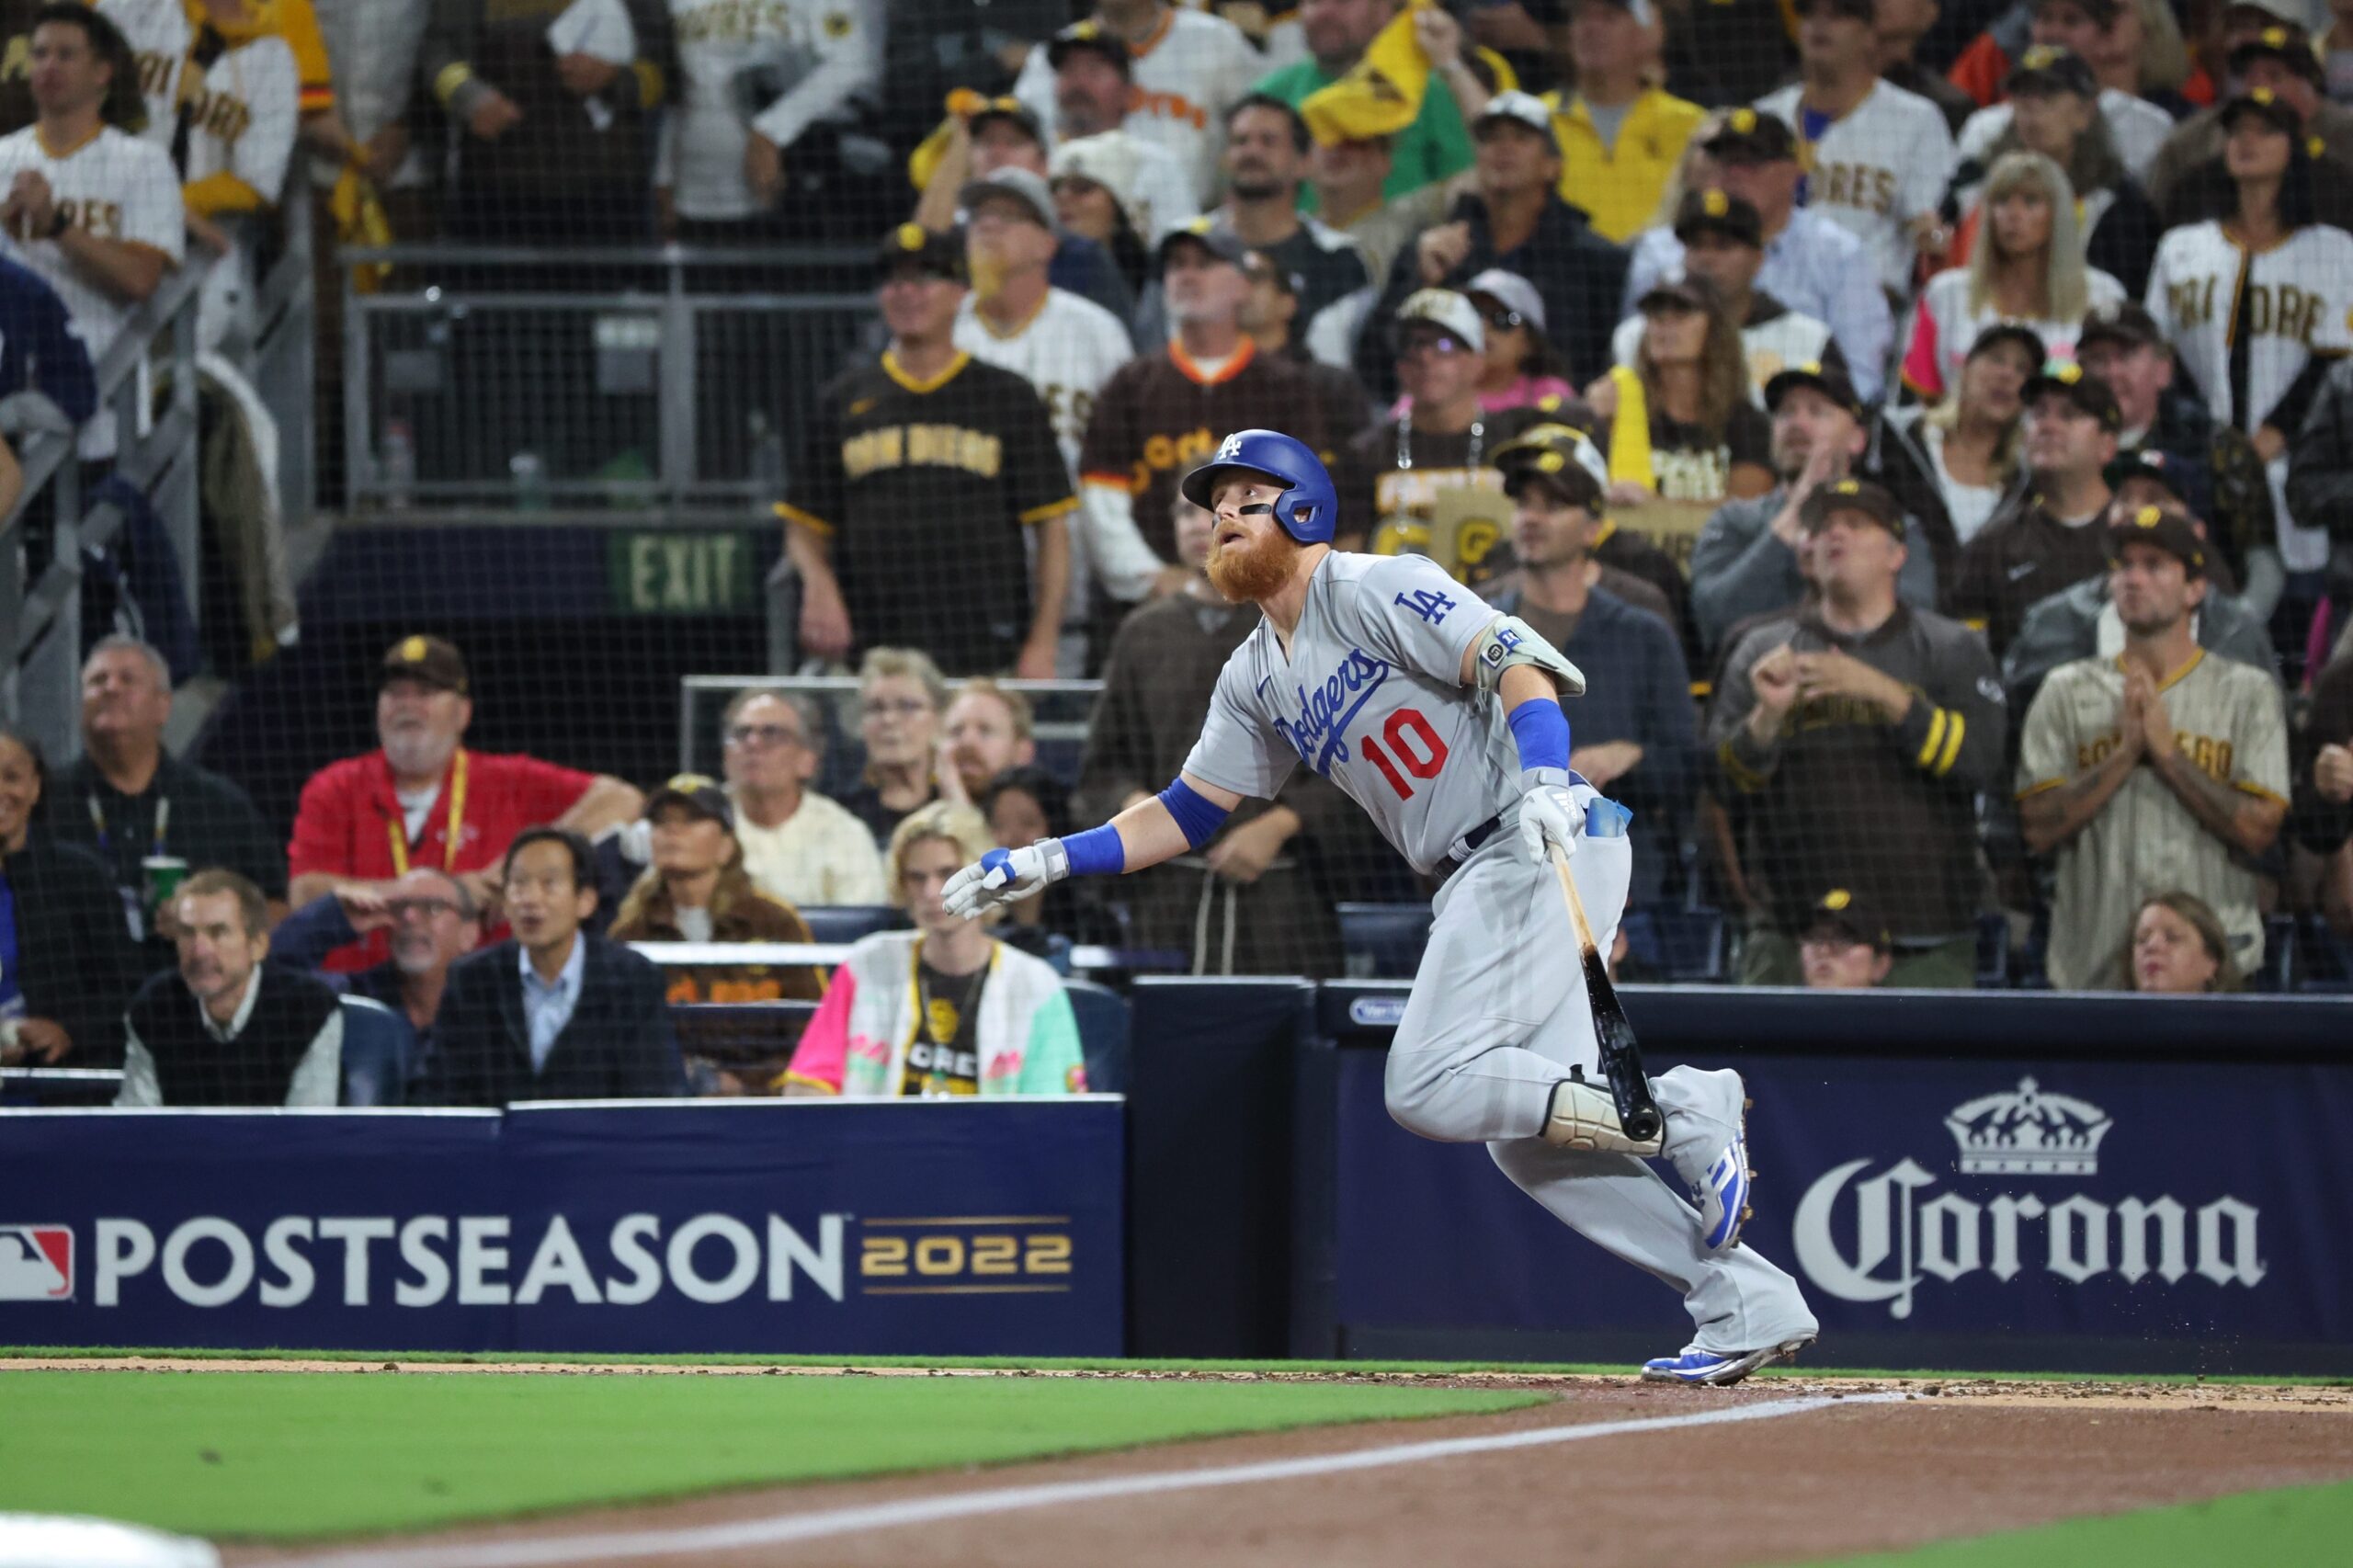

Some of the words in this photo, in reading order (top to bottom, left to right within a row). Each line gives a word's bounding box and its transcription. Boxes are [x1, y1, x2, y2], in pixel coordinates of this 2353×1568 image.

[1219, 434, 1241, 460] LA
[631, 532, 737, 612] EXIT
[1394, 589, 1457, 625] LA
[1273, 648, 1389, 779] Dodgers
[1361, 708, 1449, 801] 10
[95, 1214, 844, 1308] POSTSEASON
[861, 1235, 1073, 1277] 2022
[1793, 1156, 2267, 1320] Corona
